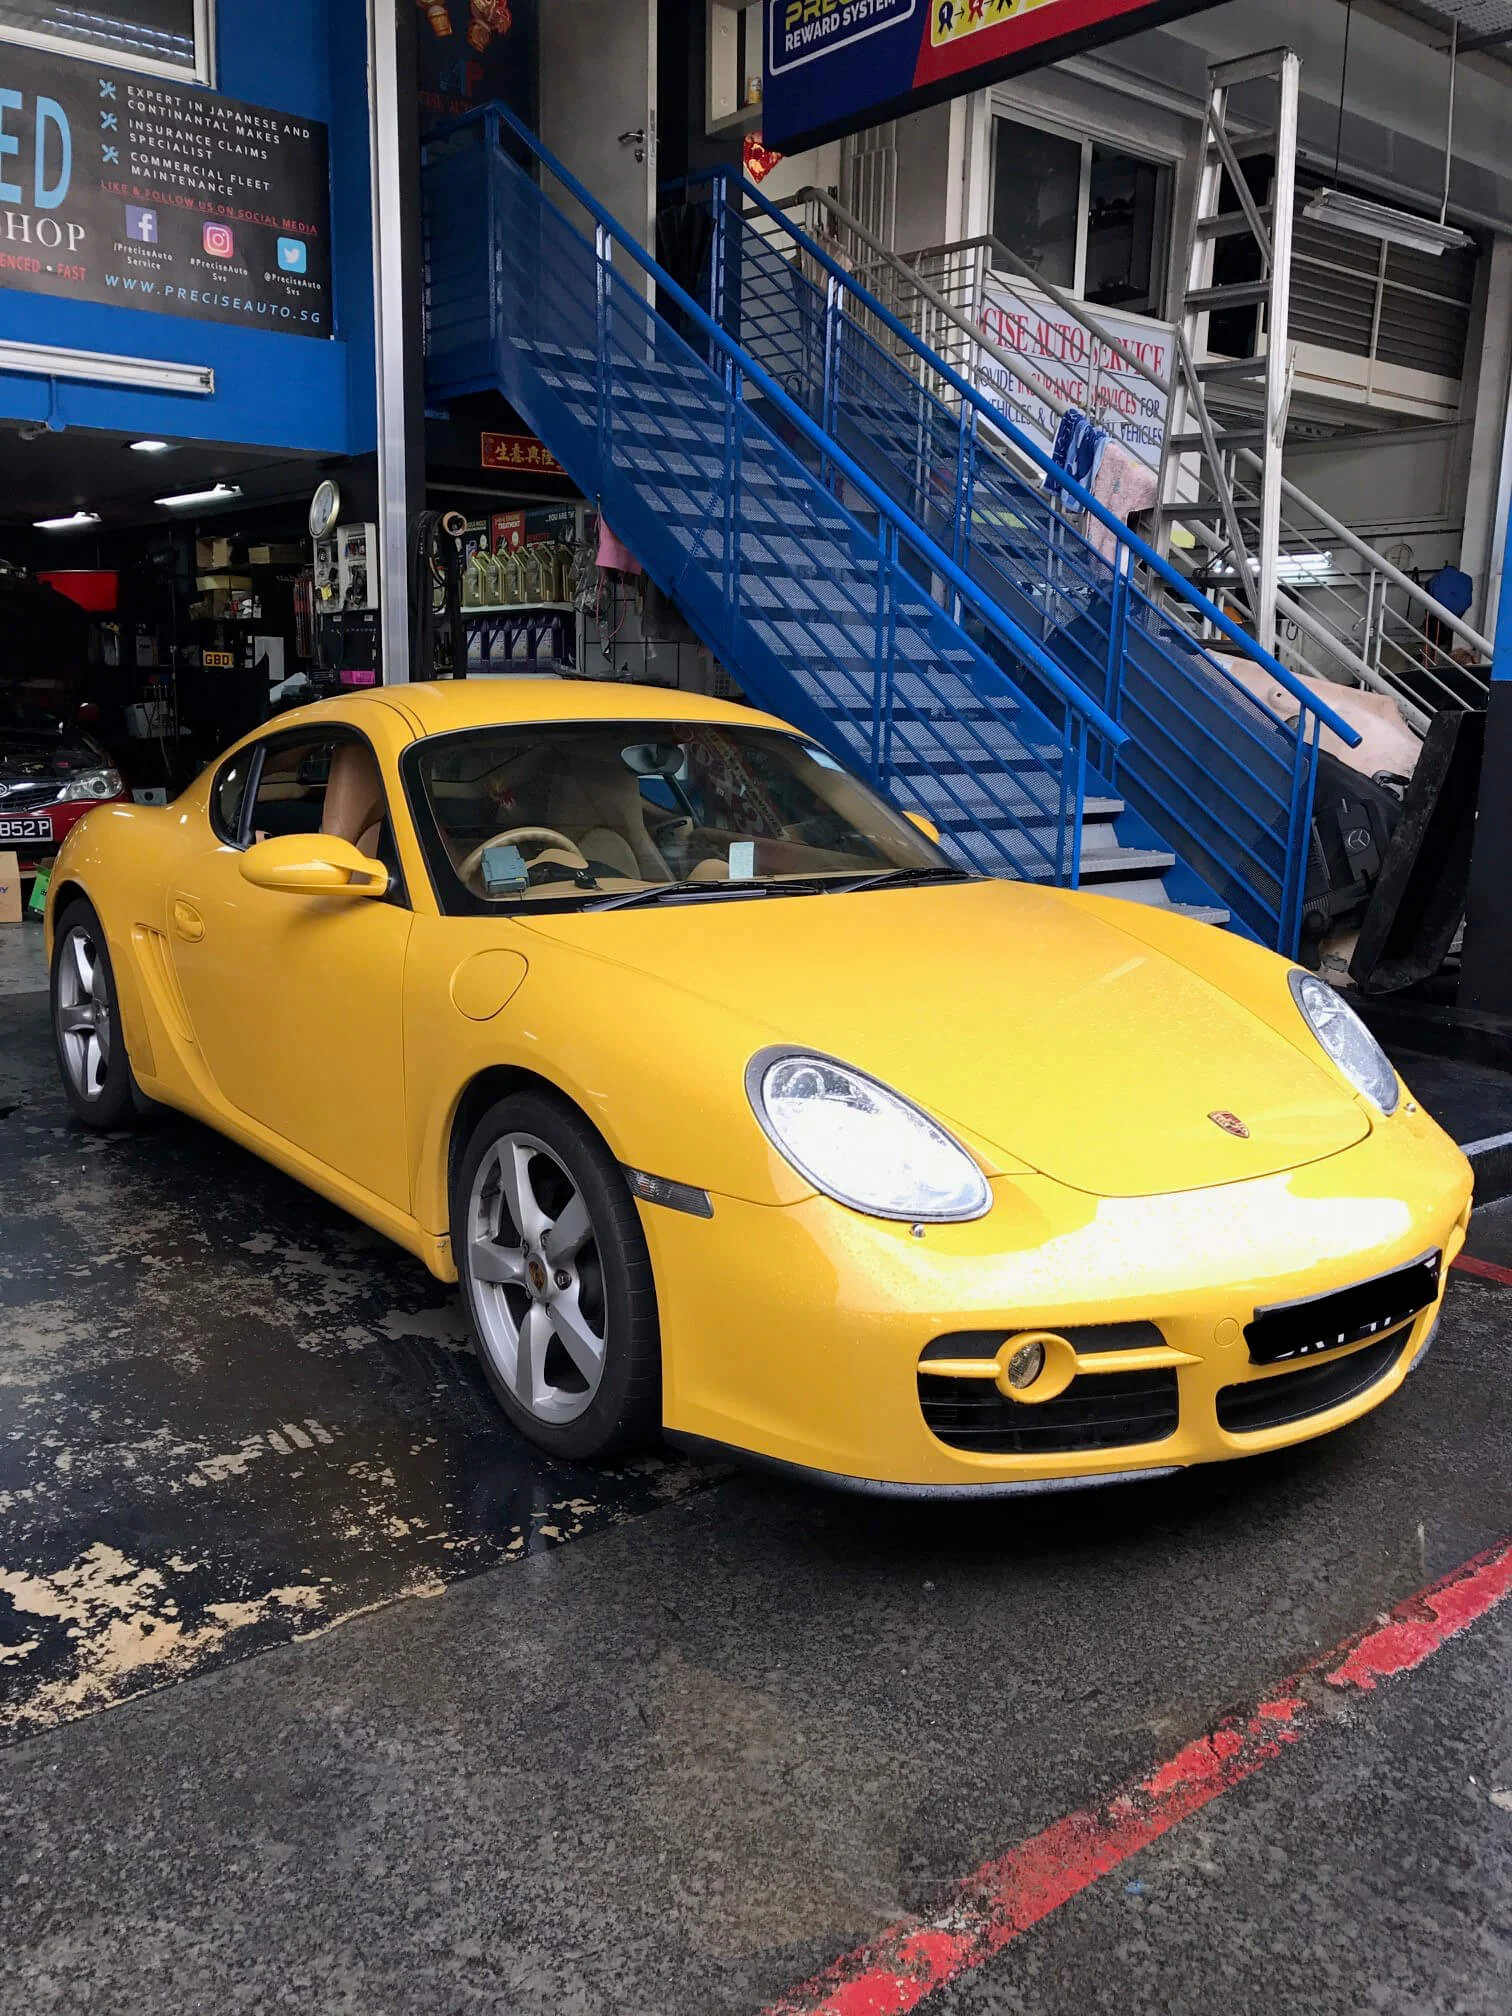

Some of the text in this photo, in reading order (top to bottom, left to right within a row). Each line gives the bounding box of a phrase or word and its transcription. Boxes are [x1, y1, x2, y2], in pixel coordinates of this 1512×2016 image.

[785, 0, 855, 31] PRE
[942, 5, 948, 19] 1
[785, 13, 840, 52] REWARD
[127, 85, 311, 139] EXPERT IN JAPANESE AND
[127, 99, 281, 144] CONTINANTAL MAKES
[129, 119, 268, 160] INSURANCE CLAIMS
[130, 132, 213, 160] SPECIALIST
[130, 152, 271, 191] COMMERCIAL FLEET
[131, 165, 234, 196] MAINTENANCE
[101, 180, 318, 233] LIKE & FOLLOW US ON SOCIAL MEDIA
[56, 263, 87, 281] FAST
[127, 256, 161, 270] Service
[212, 271, 227, 282] Svs
[263, 271, 321, 290] @PreciseAuto
[286, 286, 300, 296] Svs
[104, 273, 321, 323] WWW.PRECISEAUTO.SG
[976, 303, 1028, 352] CISE
[1032, 318, 1084, 363] AUTO
[974, 364, 1014, 392] OVIDE
[1140, 396, 1160, 418] FOR
[989, 398, 1032, 425] EHICLES
[1120, 422, 1162, 446] VEHICLES
